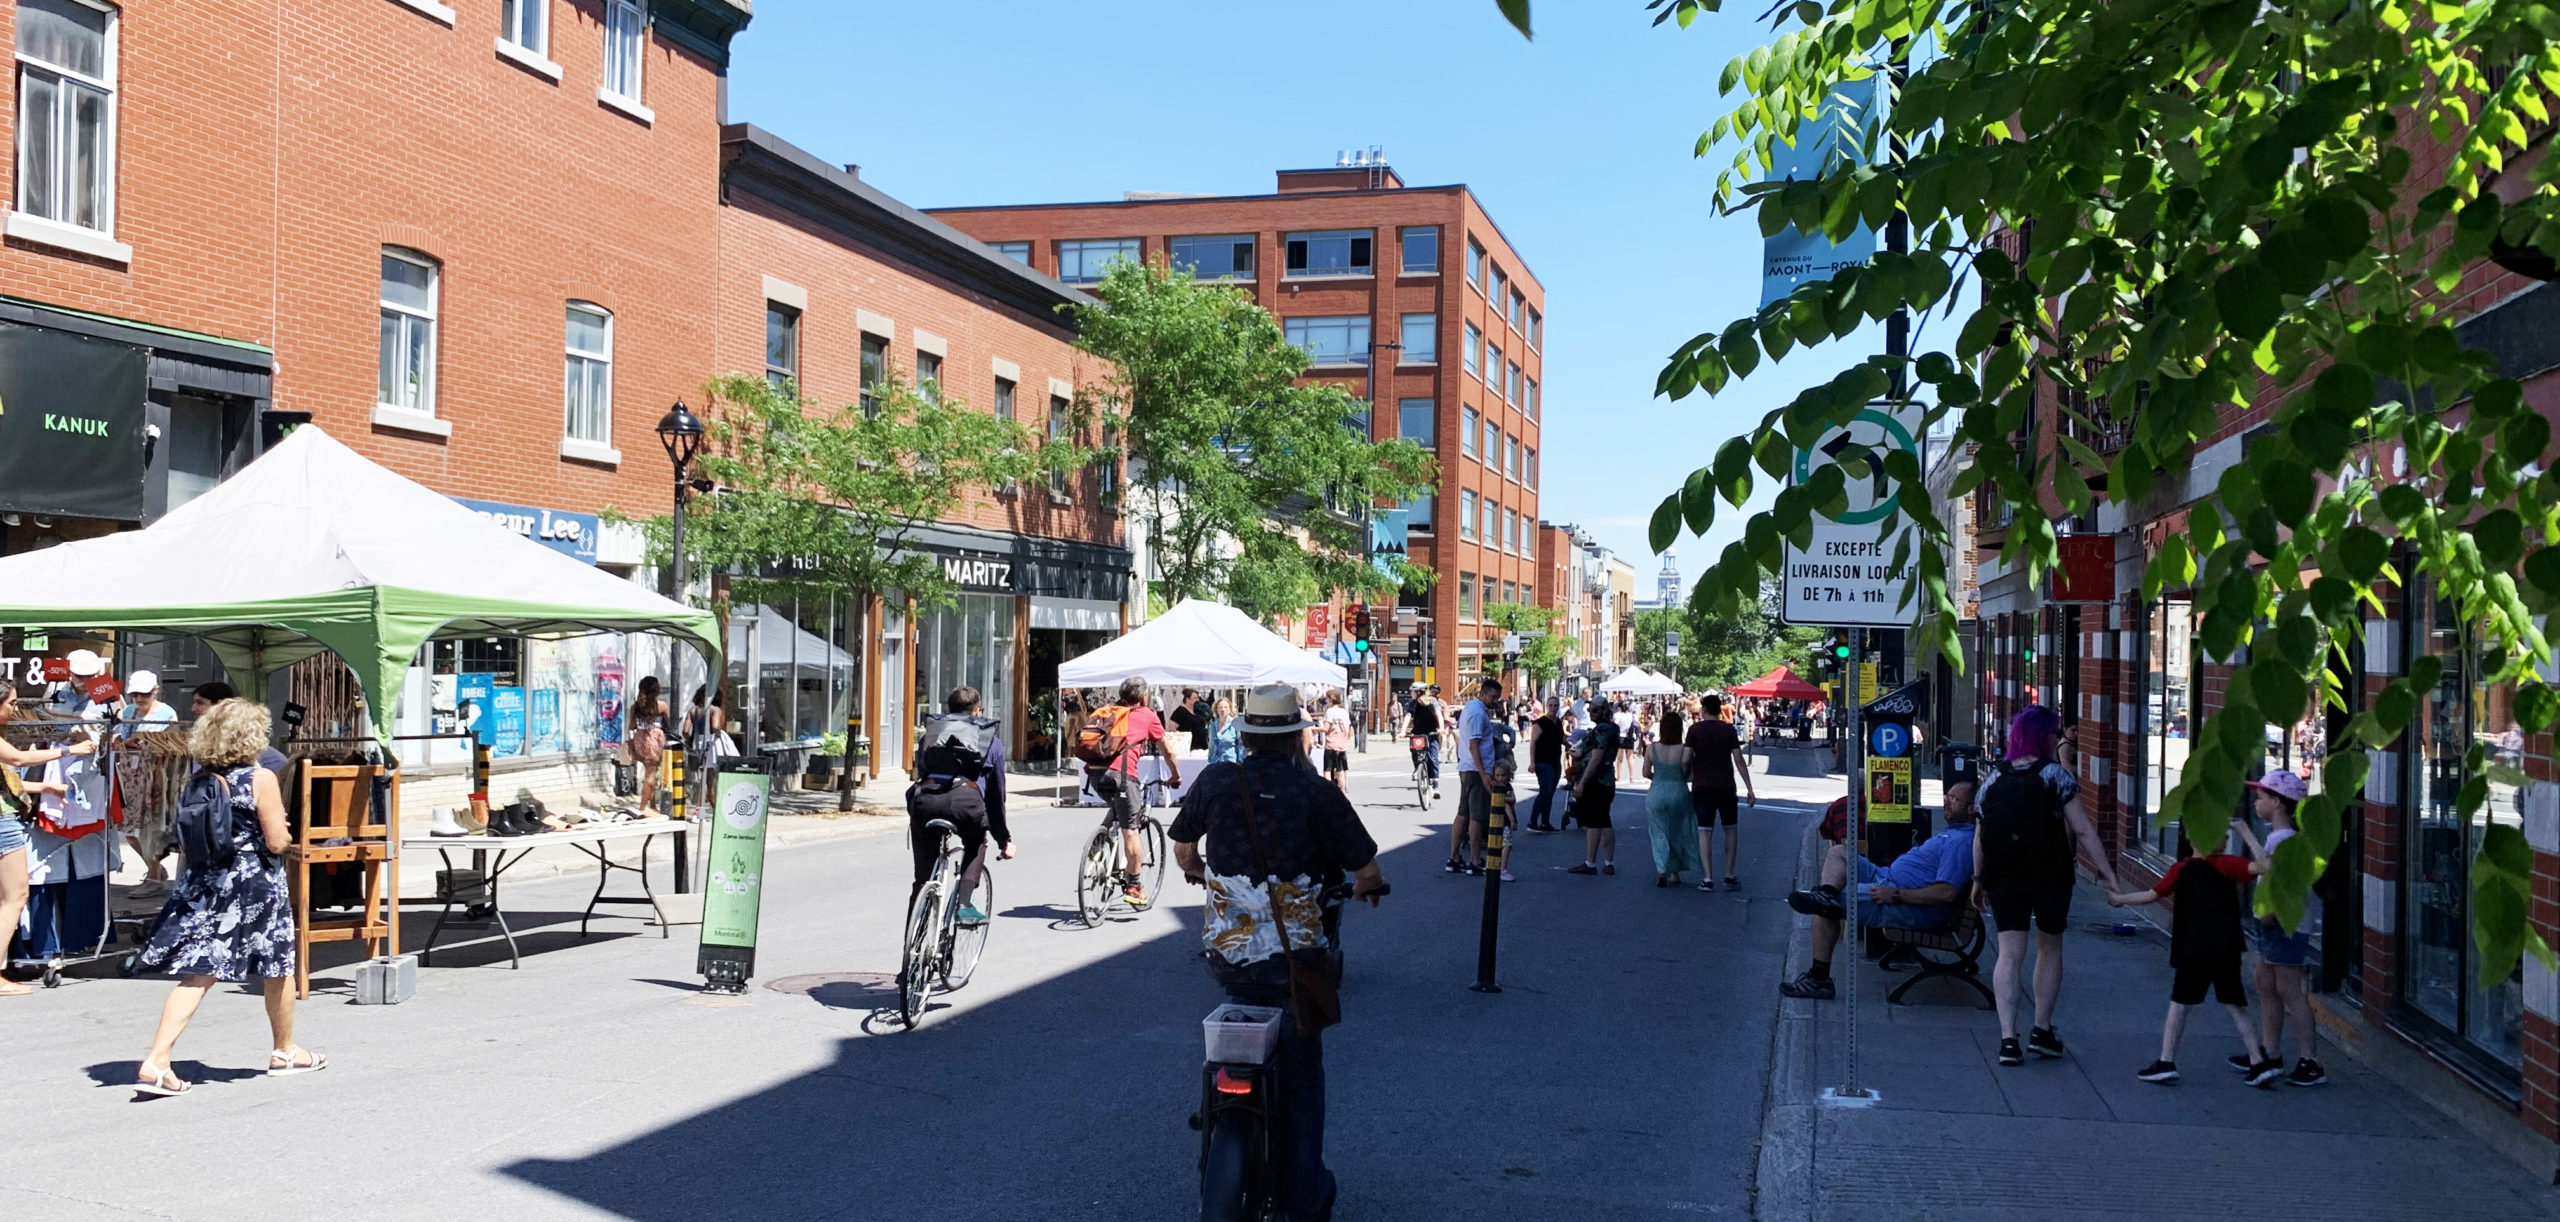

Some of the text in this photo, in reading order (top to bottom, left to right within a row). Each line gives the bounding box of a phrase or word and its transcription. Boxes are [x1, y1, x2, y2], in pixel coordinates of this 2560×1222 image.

[45, 413, 109, 437] KANUK
[539, 510, 581, 539] Lee
[1792, 564, 1861, 579] LIVRAISON
[1803, 587, 1819, 601] DE
[1824, 587, 1841, 602] 7h
[1863, 589, 1884, 603] 11h
[48, 665, 67, 675] -50%
[93, 684, 113, 696] -50%
[1870, 760, 1910, 771] FLAMENCO
